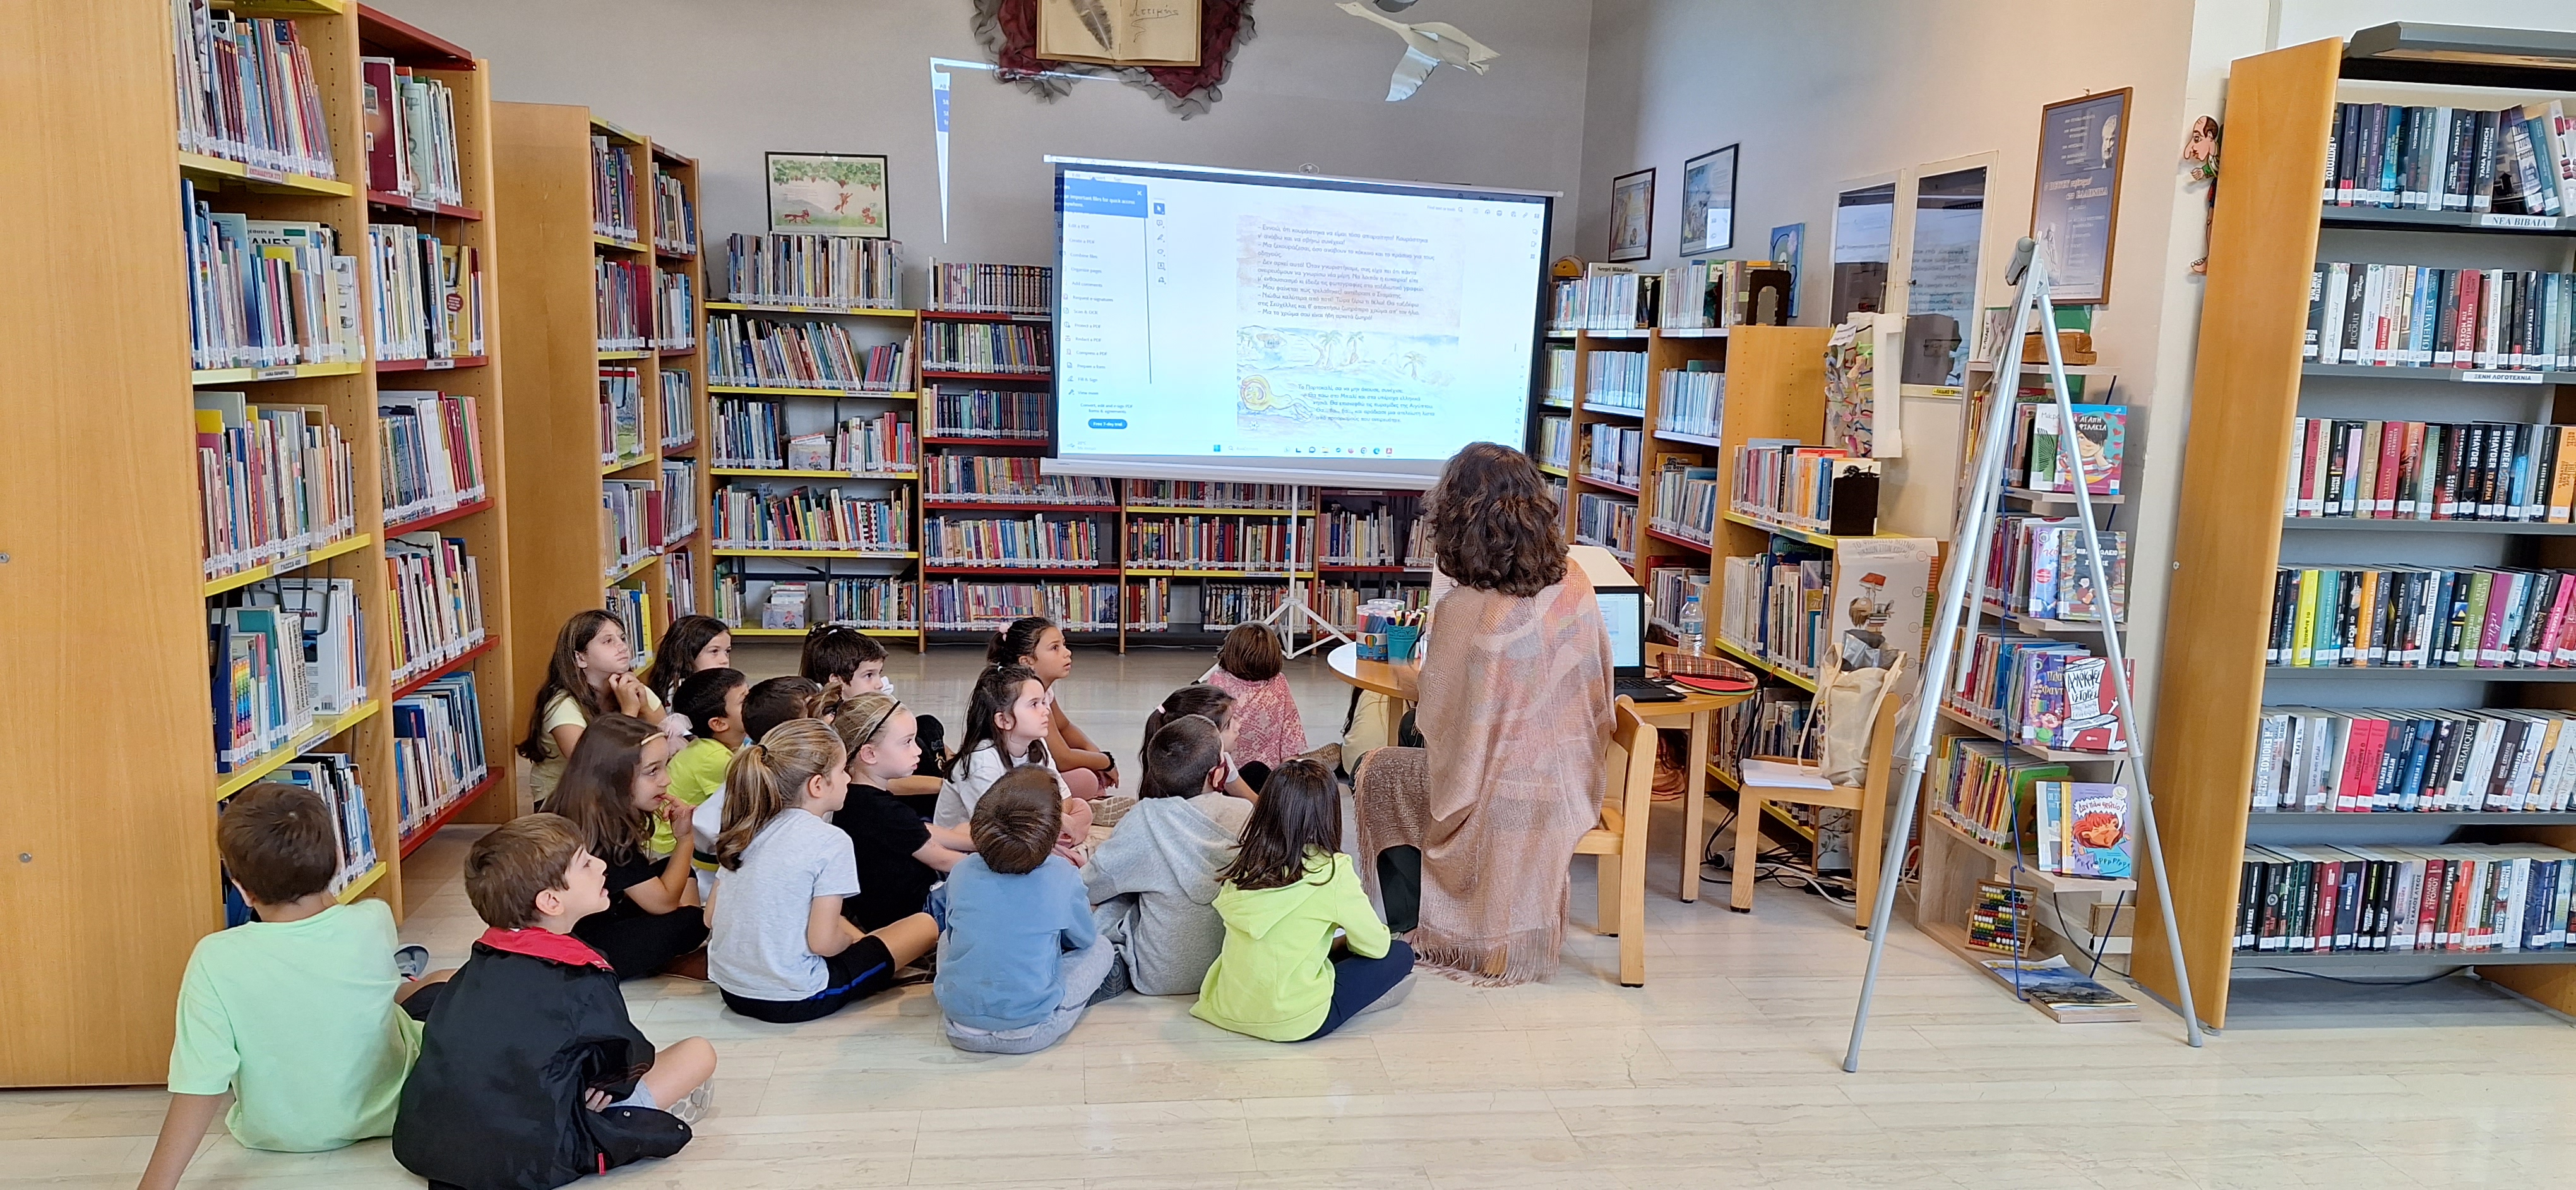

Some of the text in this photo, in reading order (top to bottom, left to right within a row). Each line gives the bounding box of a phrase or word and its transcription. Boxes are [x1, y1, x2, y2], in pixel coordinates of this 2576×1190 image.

[2481, 127, 2490, 157] FRENCH
[1292, 227, 1324, 236] κουράστηκα
[1396, 236, 1428, 244] Κουράστηκα
[2491, 216, 2548, 227] ΝΕΑ ΒΙΒΛΙΑ
[2422, 299, 2435, 350] ΣΕ ΒΛΕΠΩ
[2079, 414, 2102, 423] ΑΓΑΠΗ
[2390, 428, 2399, 457] KIMBERLEY
[2469, 436, 2481, 467] HAYDER
[2488, 436, 2500, 469] HAYDER
[2501, 436, 2515, 468] HAYDER
[2484, 480, 2493, 500] ΔΕΡΜΑ
[2474, 583, 2483, 603] RILEY
[2478, 579, 2489, 606] LUCINDA
[2259, 738, 2272, 772] ΕΝΟΙΚΟΣ
[2455, 724, 2475, 776] REMARQUE
[2414, 874, 2422, 895] ΛΥΚΟΣ
